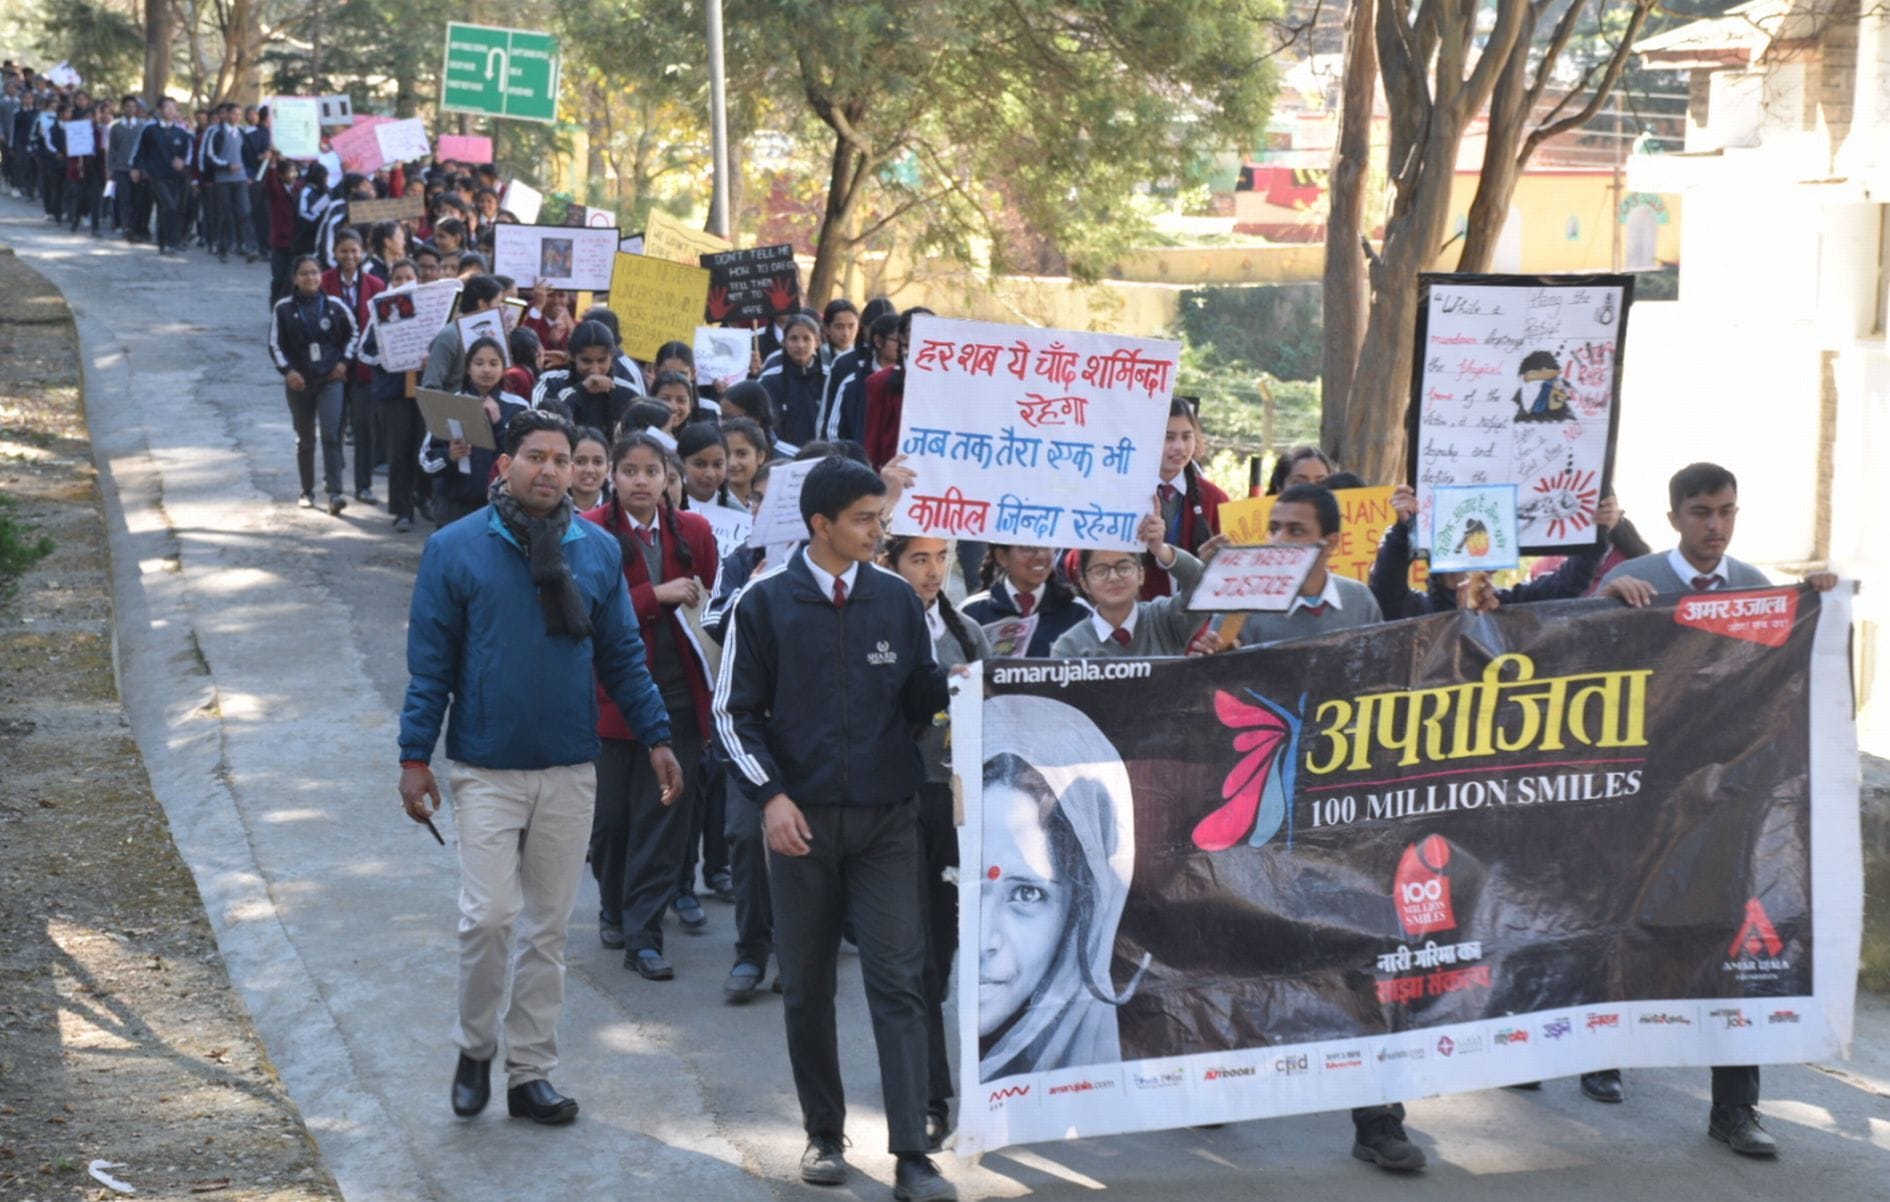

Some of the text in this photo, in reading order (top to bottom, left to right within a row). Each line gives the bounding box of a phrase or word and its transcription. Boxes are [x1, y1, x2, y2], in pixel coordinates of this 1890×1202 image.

[750, 248, 774, 260] TELL
[729, 266, 750, 277] HOW
[756, 263, 768, 274] TO
[914, 339, 955, 372] हर
[957, 343, 1003, 377] शब
[1006, 339, 1031, 381] ये
[1017, 392, 1088, 427] रहेगा
[903, 427, 951, 458] जब
[951, 432, 993, 469] तक
[1101, 437, 1136, 475] भी
[907, 486, 991, 536] कातिल
[1253, 547, 1309, 567] NEED
[1213, 575, 1296, 597] JUSTICE
[1682, 595, 1788, 621] अमर उजाला
[993, 659, 1152, 689] amarujala.com
[1305, 653, 1653, 775] अपराजिता
[1312, 769, 1643, 827] 100 MILLION SMILES
[1402, 880, 1441, 903] 100
[1406, 913, 1446, 925] SMILES
[1376, 945, 1412, 973] नारी
[1413, 940, 1456, 969] गरिमा
